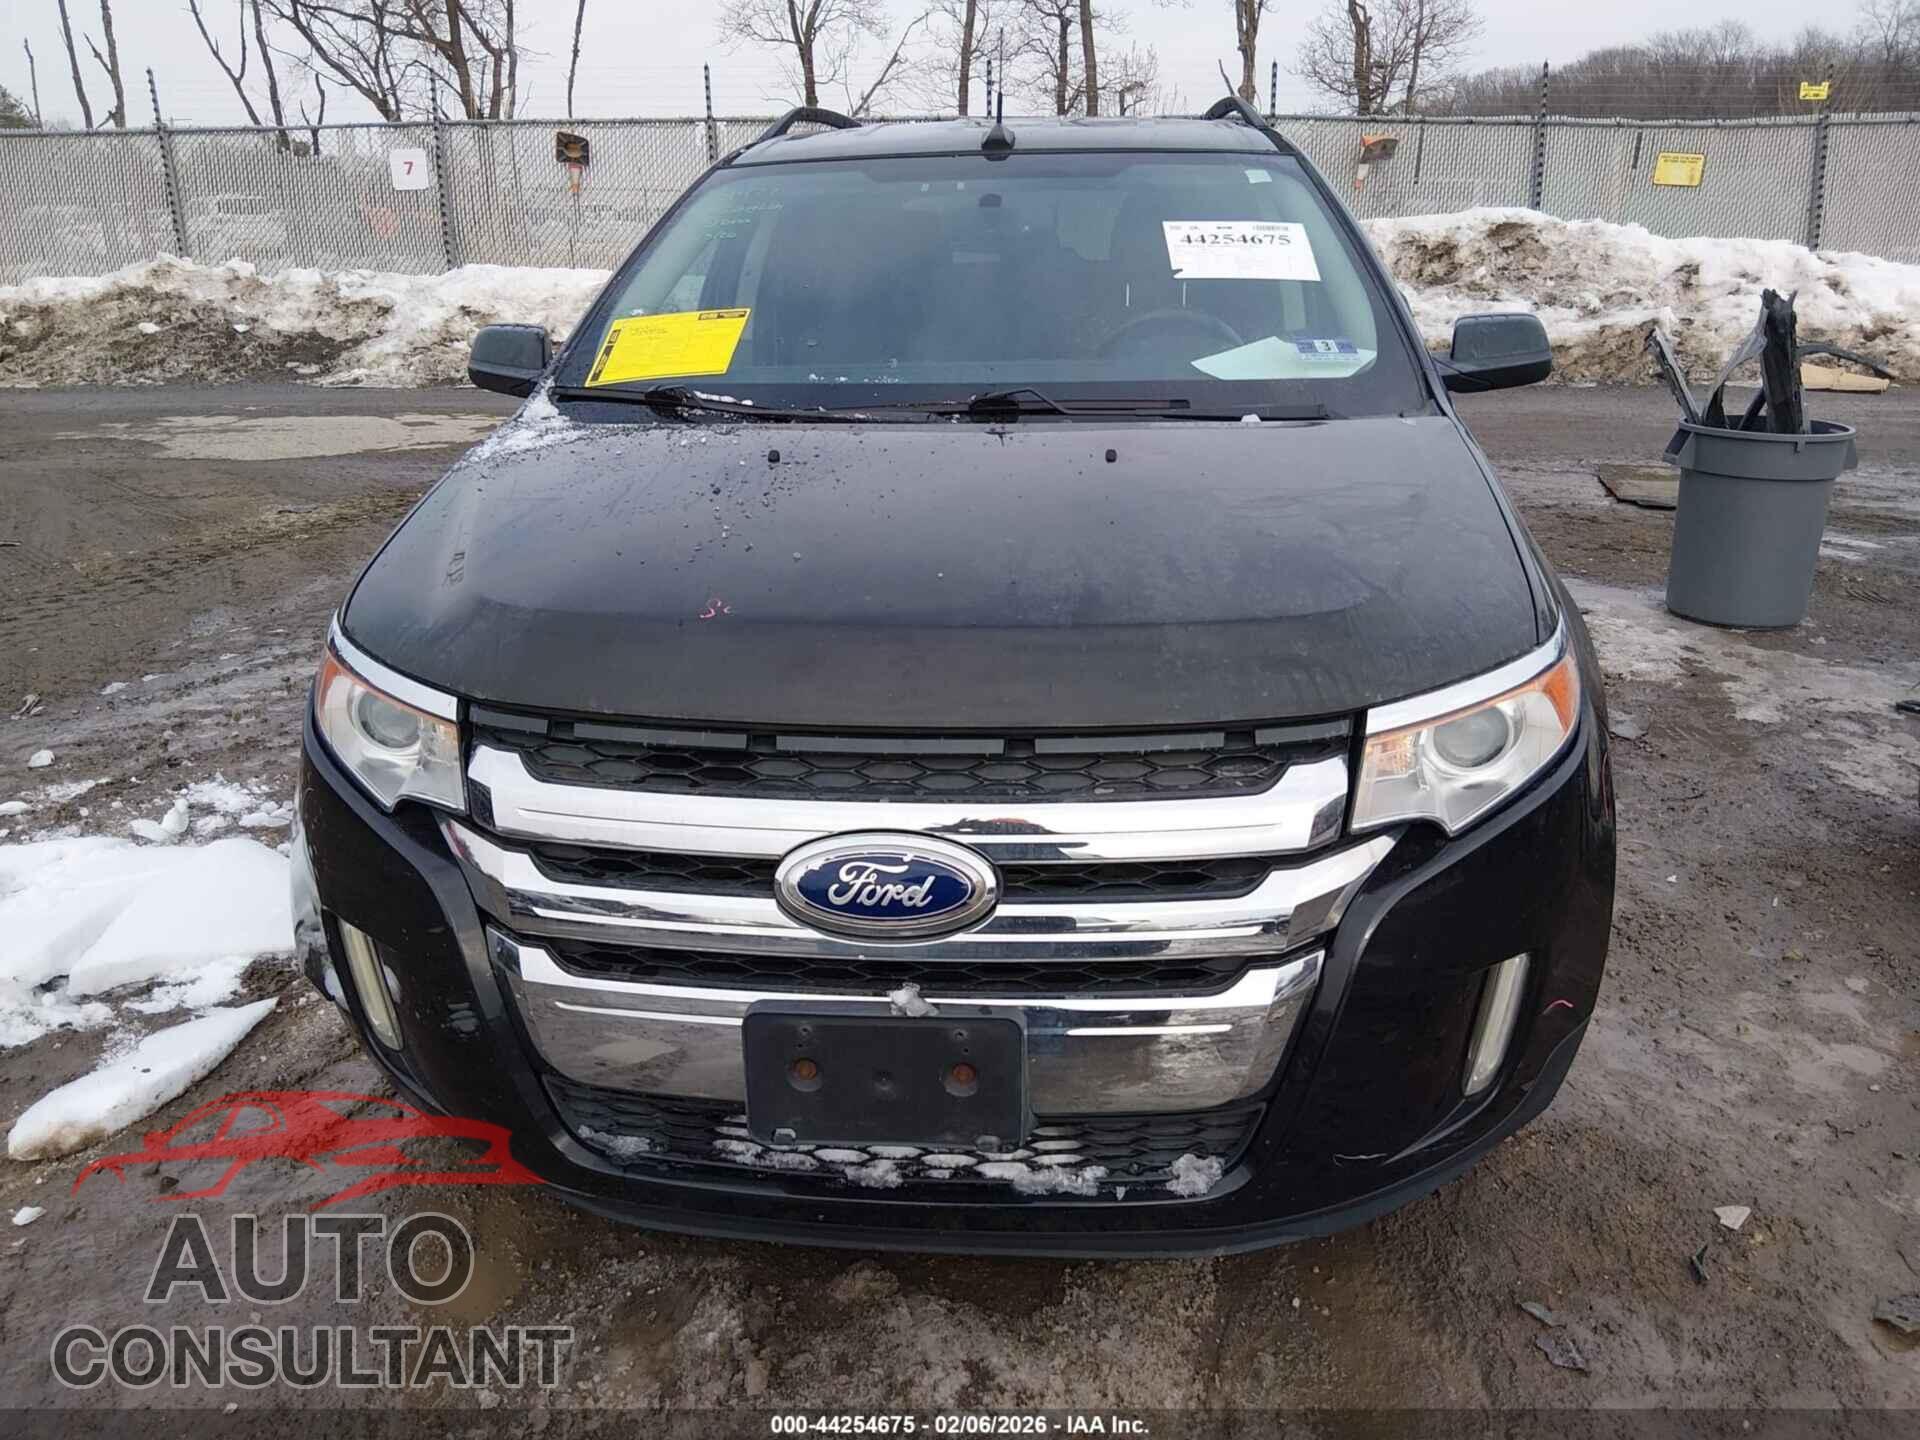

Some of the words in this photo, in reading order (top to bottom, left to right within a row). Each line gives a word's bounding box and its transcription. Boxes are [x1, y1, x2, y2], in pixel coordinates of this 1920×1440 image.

[403, 161, 414, 175] 7
[1180, 234, 1291, 245] 44254675
[1320, 340, 1331, 351] 3
[827, 861, 936, 908] Ford
